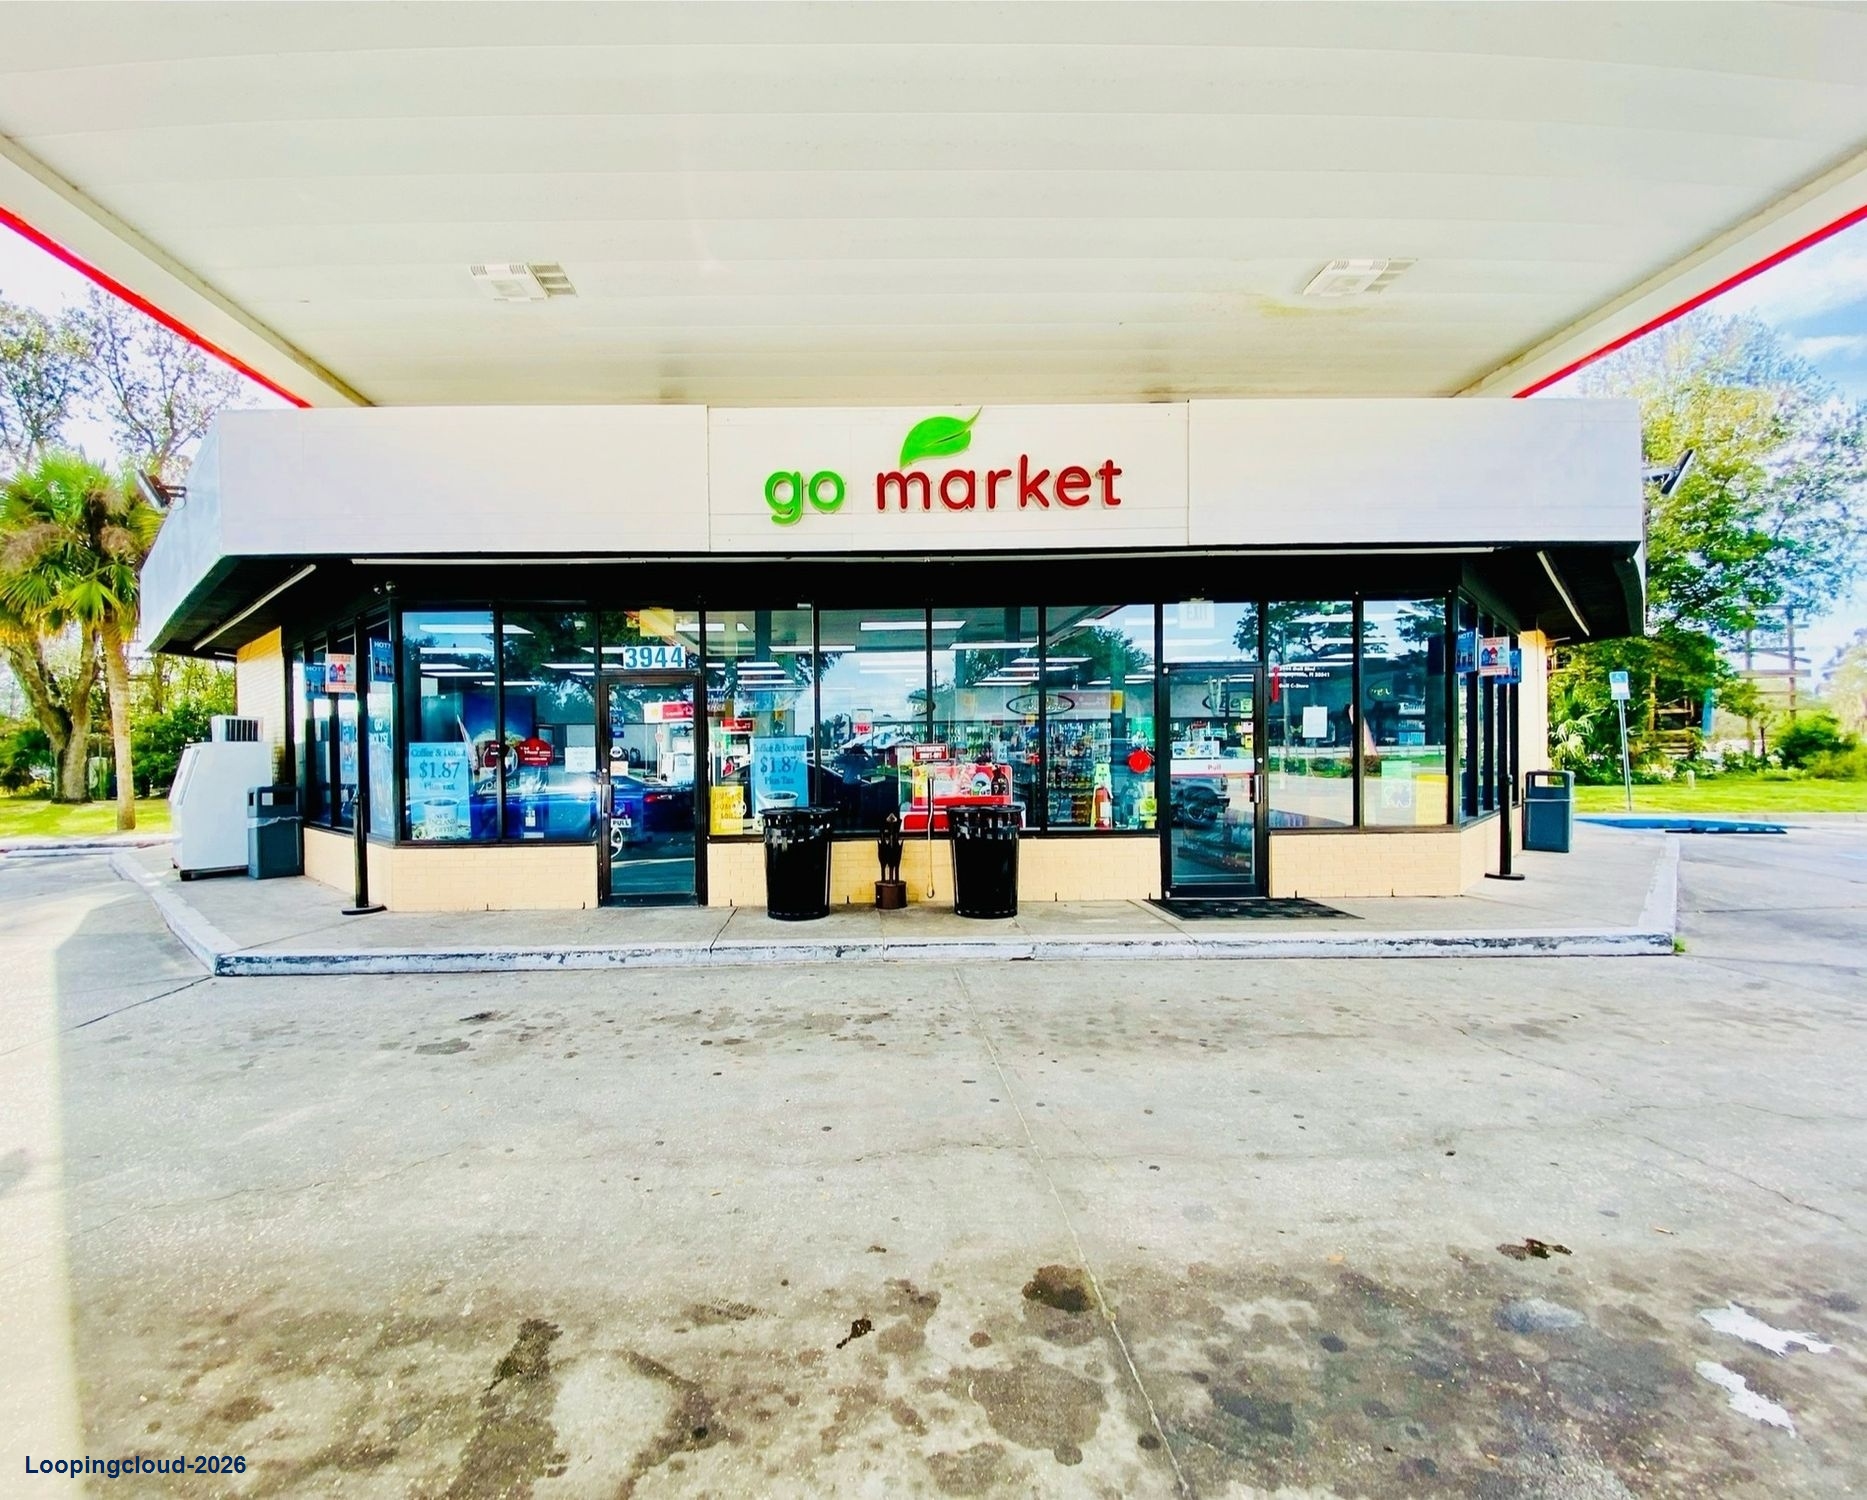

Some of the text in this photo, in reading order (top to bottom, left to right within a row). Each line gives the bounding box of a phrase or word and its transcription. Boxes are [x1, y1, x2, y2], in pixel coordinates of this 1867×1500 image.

[764, 453, 1123, 527] go market
[624, 646, 684, 668] 3944
[419, 760, 461, 780] $1.87
[760, 756, 799, 775] $1.87
